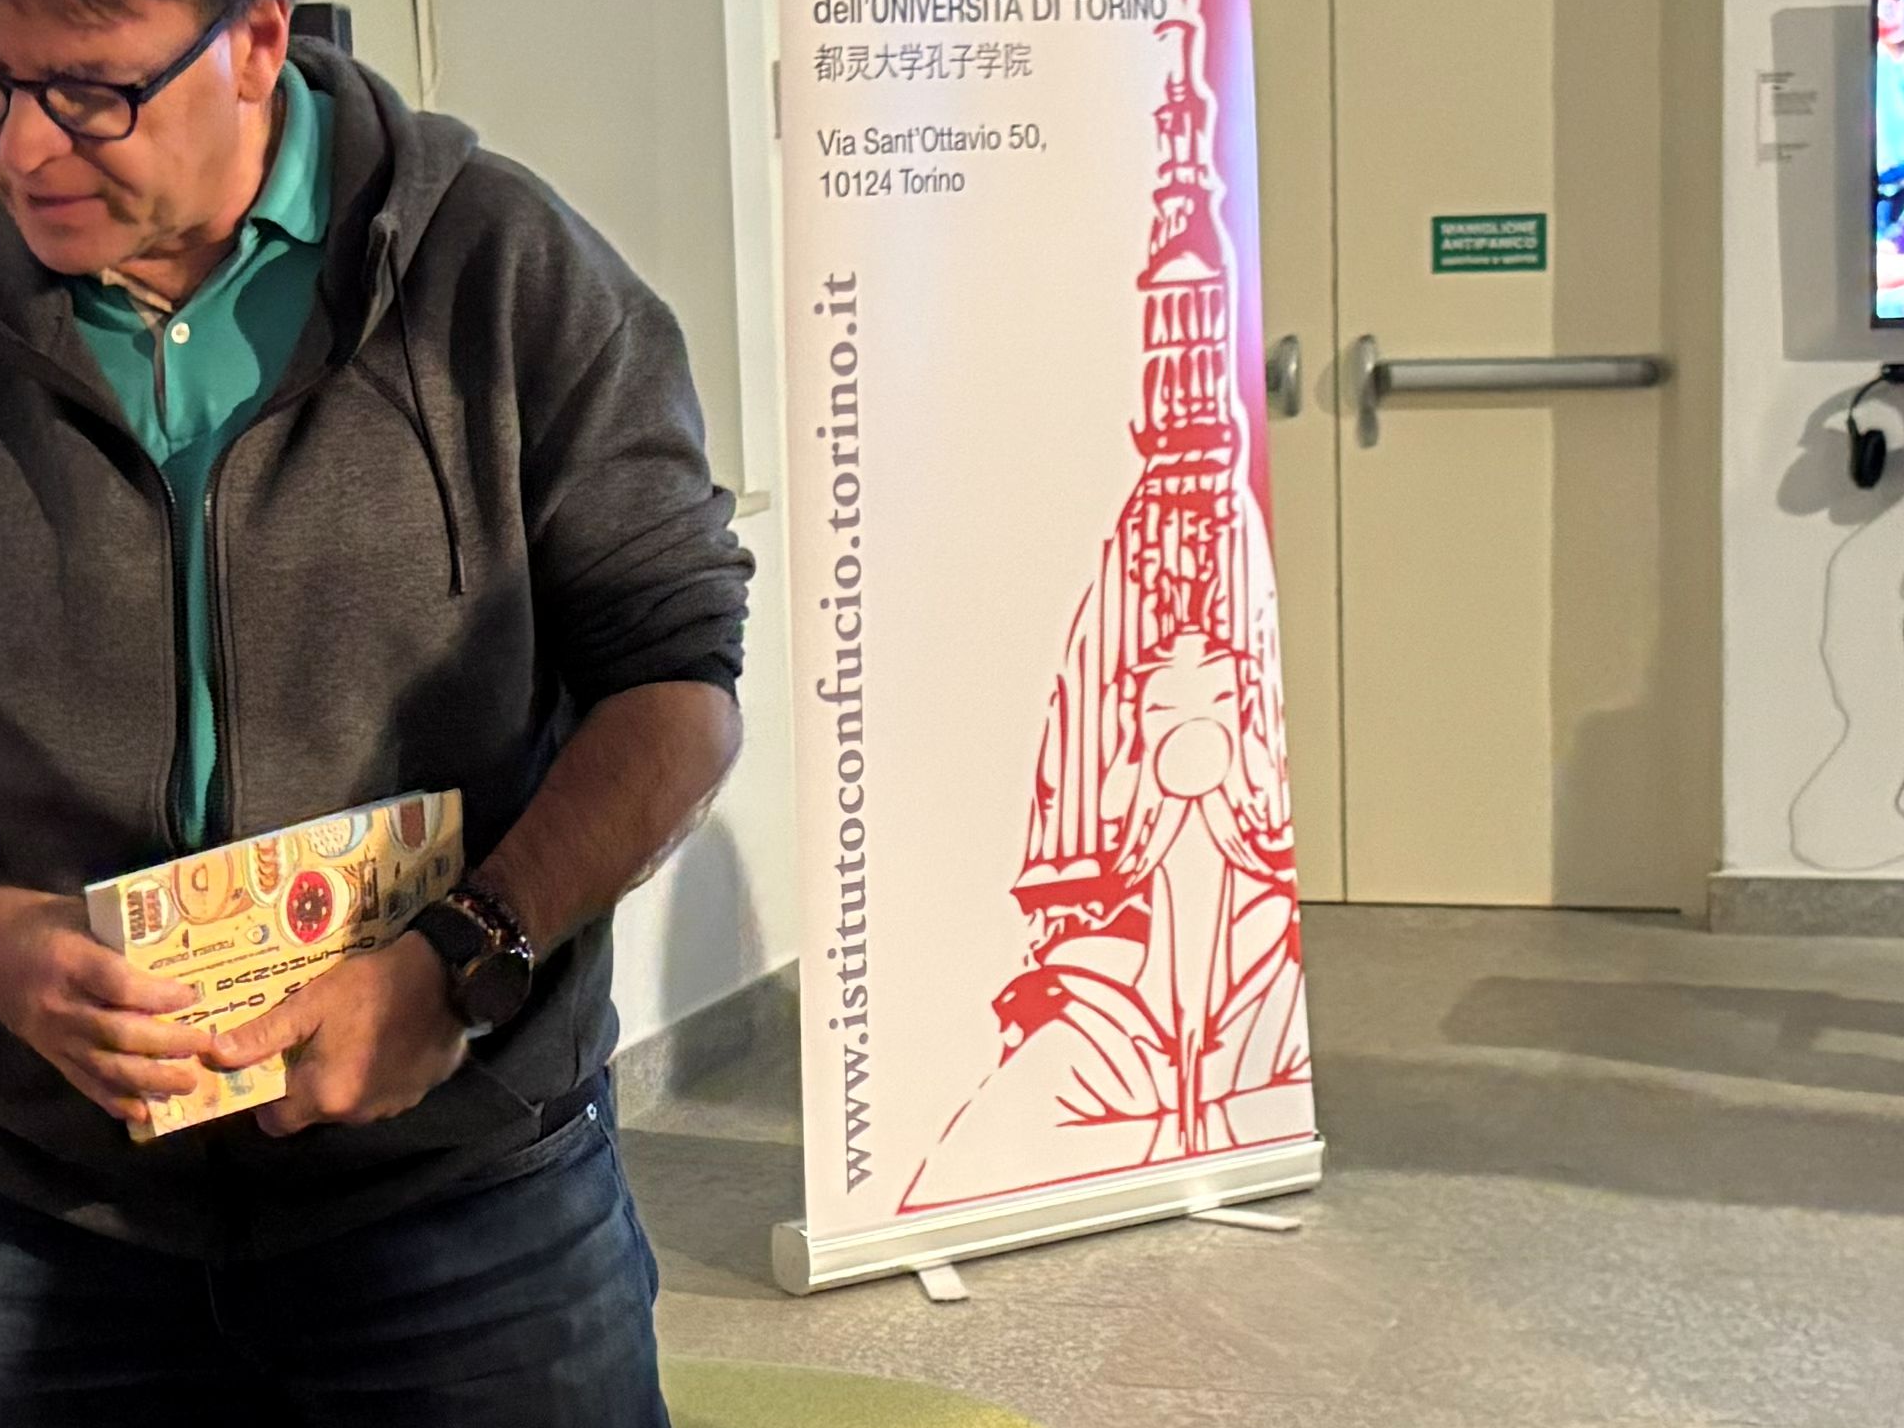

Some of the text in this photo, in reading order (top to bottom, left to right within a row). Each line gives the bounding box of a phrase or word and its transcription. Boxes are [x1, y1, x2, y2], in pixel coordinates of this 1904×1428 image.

[813, 42, 1033, 82] 都灵大学孔子学院
[816, 123, 1047, 156] Via Sant'Ottavio 50,
[820, 166, 966, 198] 10124 Torino
[814, 270, 874, 1196] www.istitutoconfucio.torino.it
[216, 936, 377, 992] BANCHETTO
